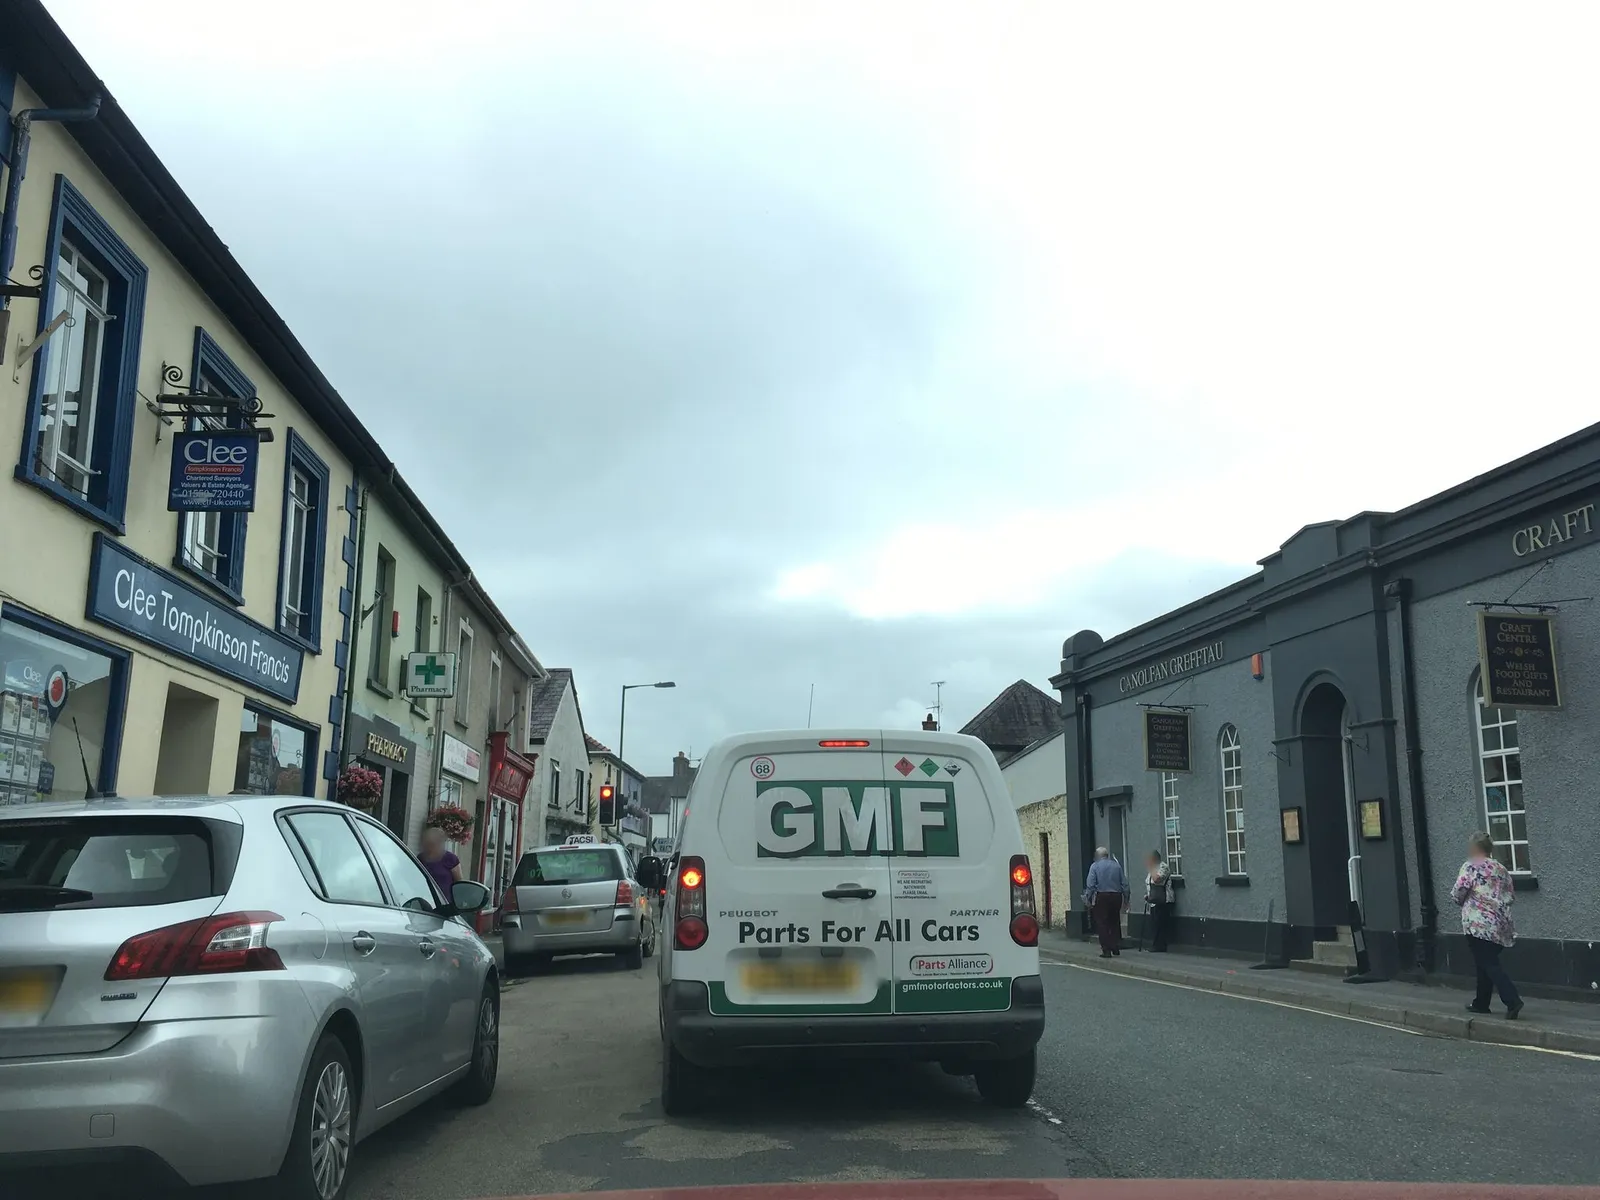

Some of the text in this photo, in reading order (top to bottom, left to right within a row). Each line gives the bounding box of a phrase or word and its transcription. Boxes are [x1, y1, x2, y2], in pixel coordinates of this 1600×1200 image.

[184, 439, 247, 463] Clee
[187, 465, 242, 473] Tompkinson Francis
[212, 490, 244, 498] 720440
[1512, 504, 1595, 556] CRAFT
[115, 569, 290, 684] Clee Tompkinson Francis
[1499, 622, 1532, 633] CRAFT
[1496, 633, 1538, 643] CENTRE
[1119, 641, 1223, 692] CANOLFAN GREFFTAU
[1505, 661, 1535, 671] WELSH
[1495, 669, 1548, 680] FOOD GIFTS
[1512, 679, 1533, 688] AND
[410, 685, 448, 694] Pharmacy
[1496, 687, 1551, 697] RESTAURANT
[367, 732, 408, 763] PHARMACY
[755, 764, 770, 774] 68
[755, 786, 948, 854] GMF
[569, 836, 594, 844] TACSI
[719, 909, 999, 918] PEUGEOT PARTNER
[738, 919, 980, 944] Parts For All Cars
[948, 958, 987, 969] Alliance
[902, 980, 1003, 993] gmfmotorfactors.co.uk
